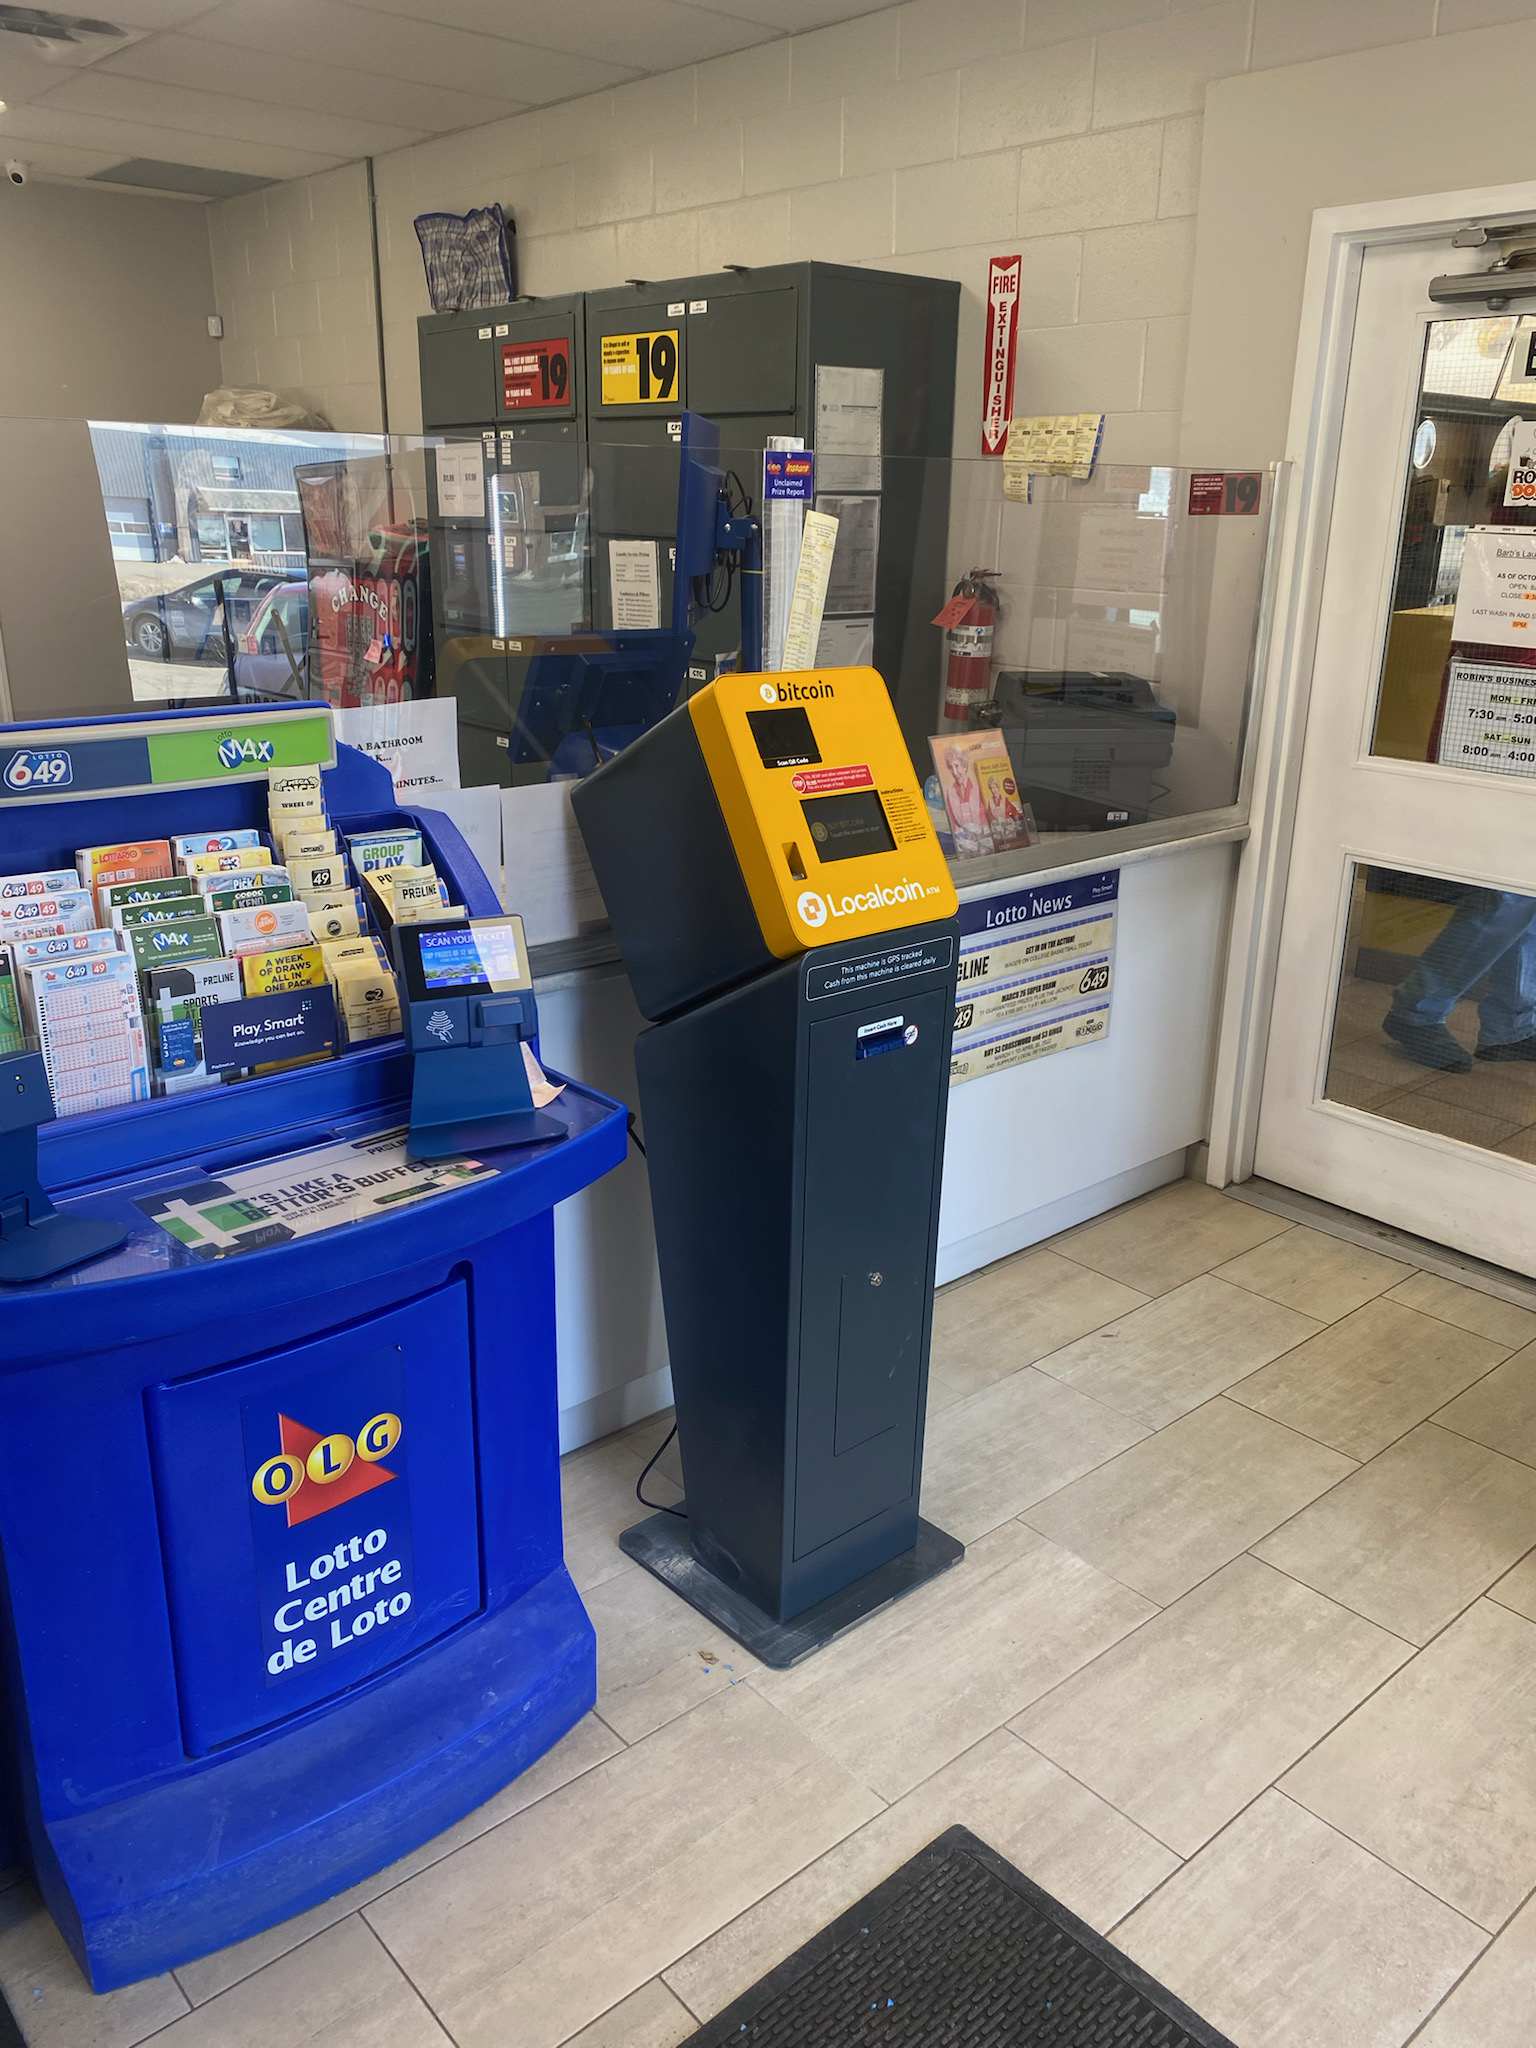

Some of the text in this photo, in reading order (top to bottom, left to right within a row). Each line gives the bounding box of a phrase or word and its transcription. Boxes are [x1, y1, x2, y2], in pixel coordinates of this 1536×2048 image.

[992, 274, 1016, 295] FIRE
[636, 335, 676, 399] 19
[988, 301, 1008, 439] EXTINGUISHER
[538, 353, 567, 400] 19
[786, 488, 805, 496] Report
[1226, 478, 1258, 512] 19
[332, 585, 388, 621] CHANGE
[1456, 672, 1493, 682] ROBIN'S
[777, 680, 835, 702] bitcoin
[1490, 694, 1511, 703] MON
[1468, 708, 1494, 719] 7:30
[366, 736, 423, 750] BATHROOM
[1484, 733, 1531, 744] SAT SUN
[32, 752, 63, 761] LOTTO
[218, 738, 272, 768] MAX
[796, 757, 809, 765] Code
[1463, 745, 1488, 756] 8:00
[1508, 751, 1535, 762] 4:00
[363, 845, 404, 860] GROUP
[314, 873, 329, 885] 49
[826, 877, 926, 917] Localcoin
[42, 906, 55, 916] 49
[986, 894, 1072, 928] Lotto News
[75, 939, 87, 948] 49
[153, 932, 189, 951] MAX
[426, 937, 450, 947] SCAN
[1025, 946, 1035, 955] GET
[265, 953, 304, 966] A WEEK
[841, 966, 854, 975] This
[855, 960, 880, 971] machine
[887, 954, 900, 964] GPS
[901, 949, 923, 960] tracked
[66, 963, 105, 978] 649 49
[259, 962, 312, 976] OF DRAWS
[272, 971, 302, 983] ALL IN
[824, 980, 840, 989] Cash
[841, 976, 856, 985] from
[857, 973, 868, 981] this
[869, 967, 894, 979] machine
[901, 959, 922, 970] cleared
[922, 956, 937, 966] daily
[264, 979, 313, 993] ONE PACK
[183, 994, 219, 1007] SPORTS
[263, 1013, 304, 1031] Smart
[234, 1038, 264, 1047] Knowledge
[230, 1173, 350, 1211] IT'S LIKE A
[242, 1182, 356, 1221] BETTOR'S
[262, 1418, 388, 1496] OLG
[285, 1528, 388, 1592] Lotto
[273, 1559, 402, 1634] Centre
[266, 1590, 412, 1676] de Loto
